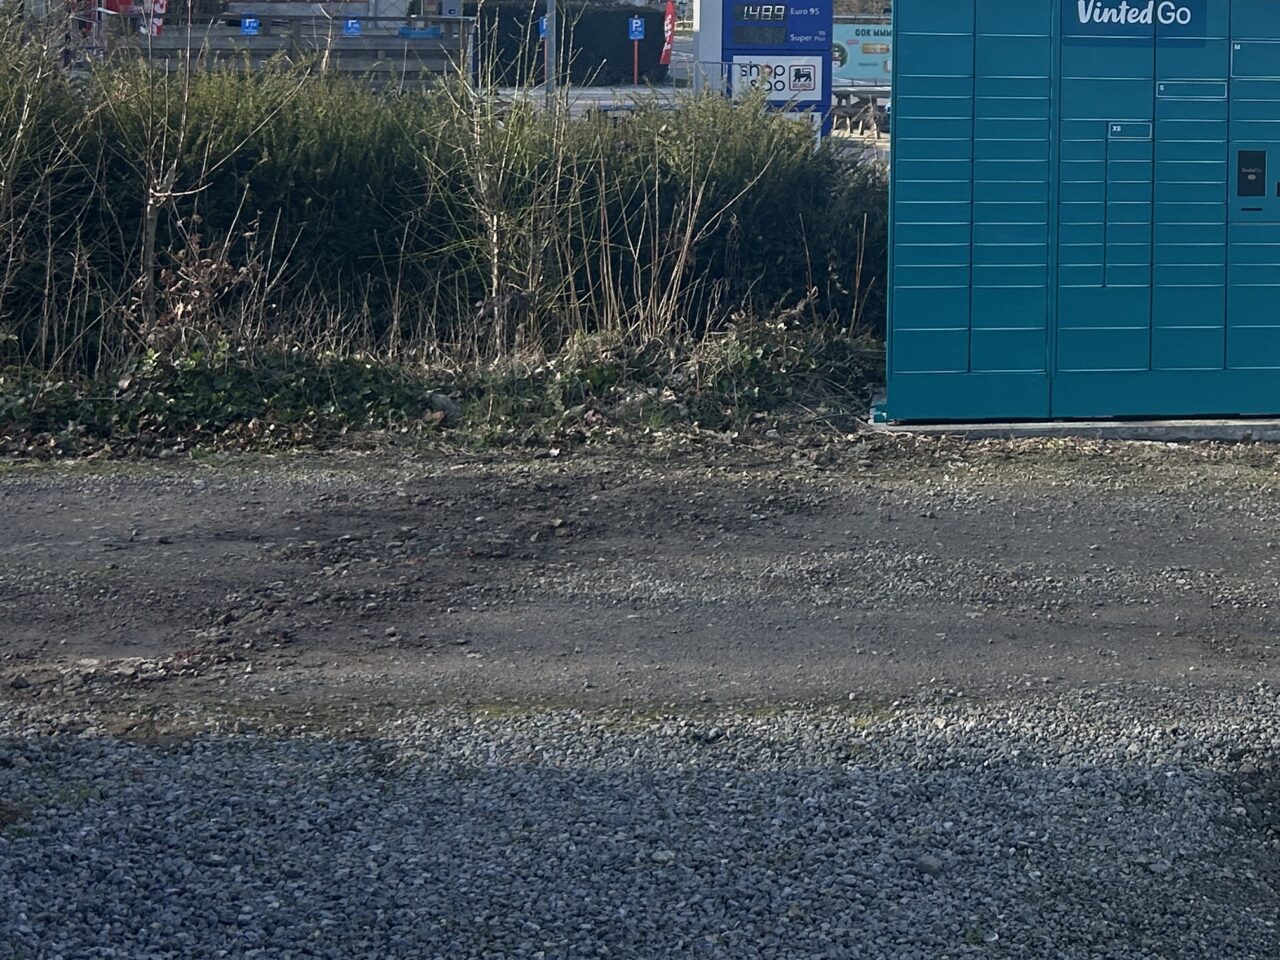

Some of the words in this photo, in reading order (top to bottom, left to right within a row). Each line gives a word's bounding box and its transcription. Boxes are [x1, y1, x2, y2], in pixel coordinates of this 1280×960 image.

[790, 7, 808, 15] Euro
[1077, 0, 1154, 24] Vinted
[1157, 1, 1191, 24] Go
[790, 33, 812, 43] Super
